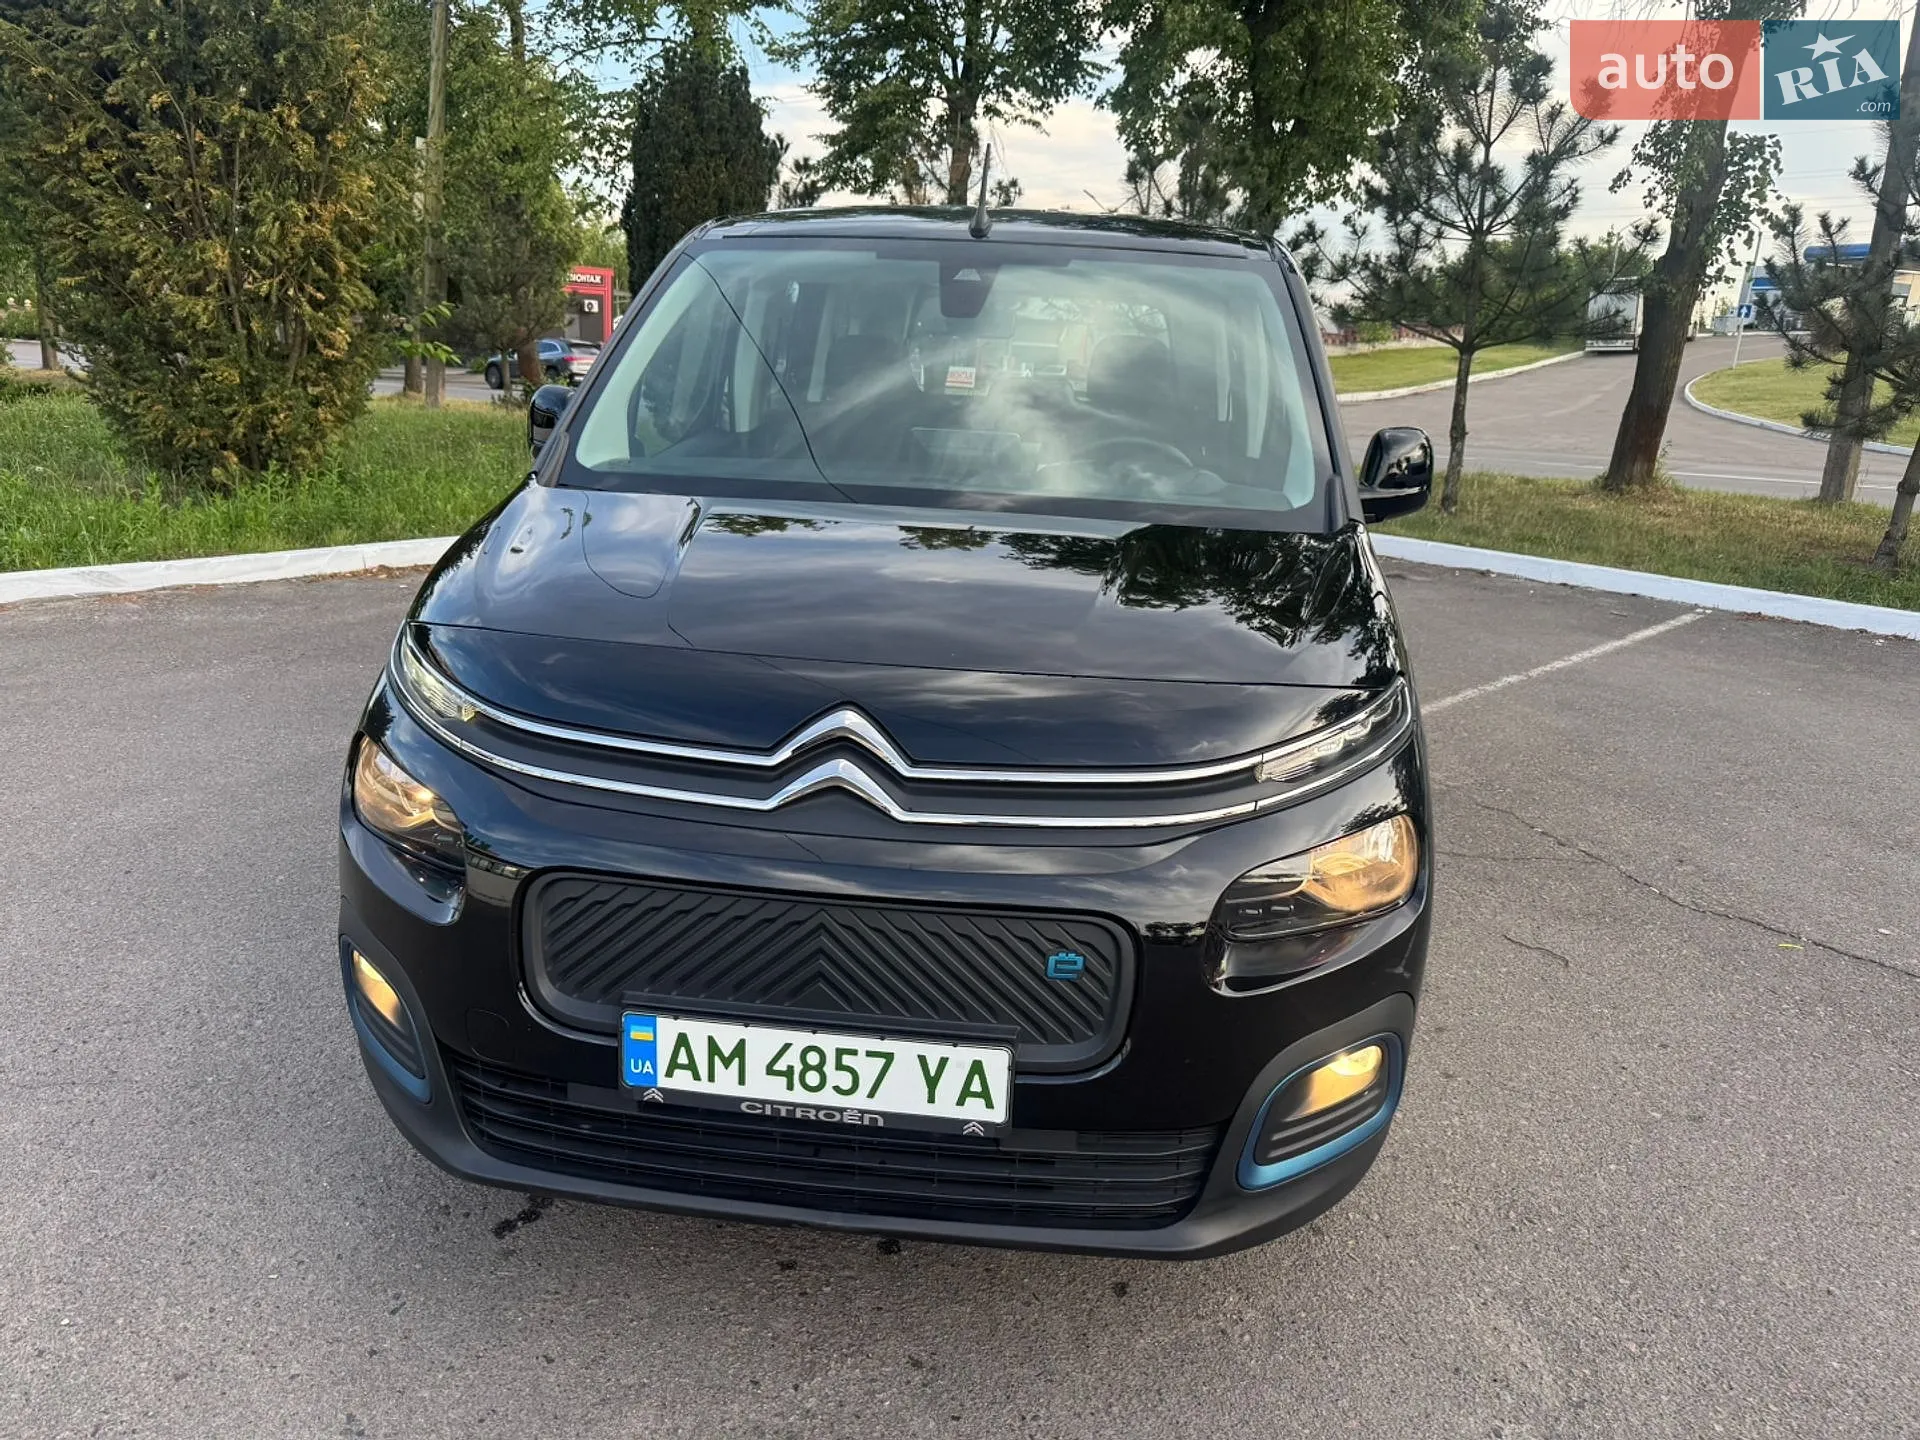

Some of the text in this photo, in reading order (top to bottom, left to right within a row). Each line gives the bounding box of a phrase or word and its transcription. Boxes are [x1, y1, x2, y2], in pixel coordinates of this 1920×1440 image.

[630, 1057, 654, 1075] UA
[664, 1032, 995, 1111] AM 4857 YA
